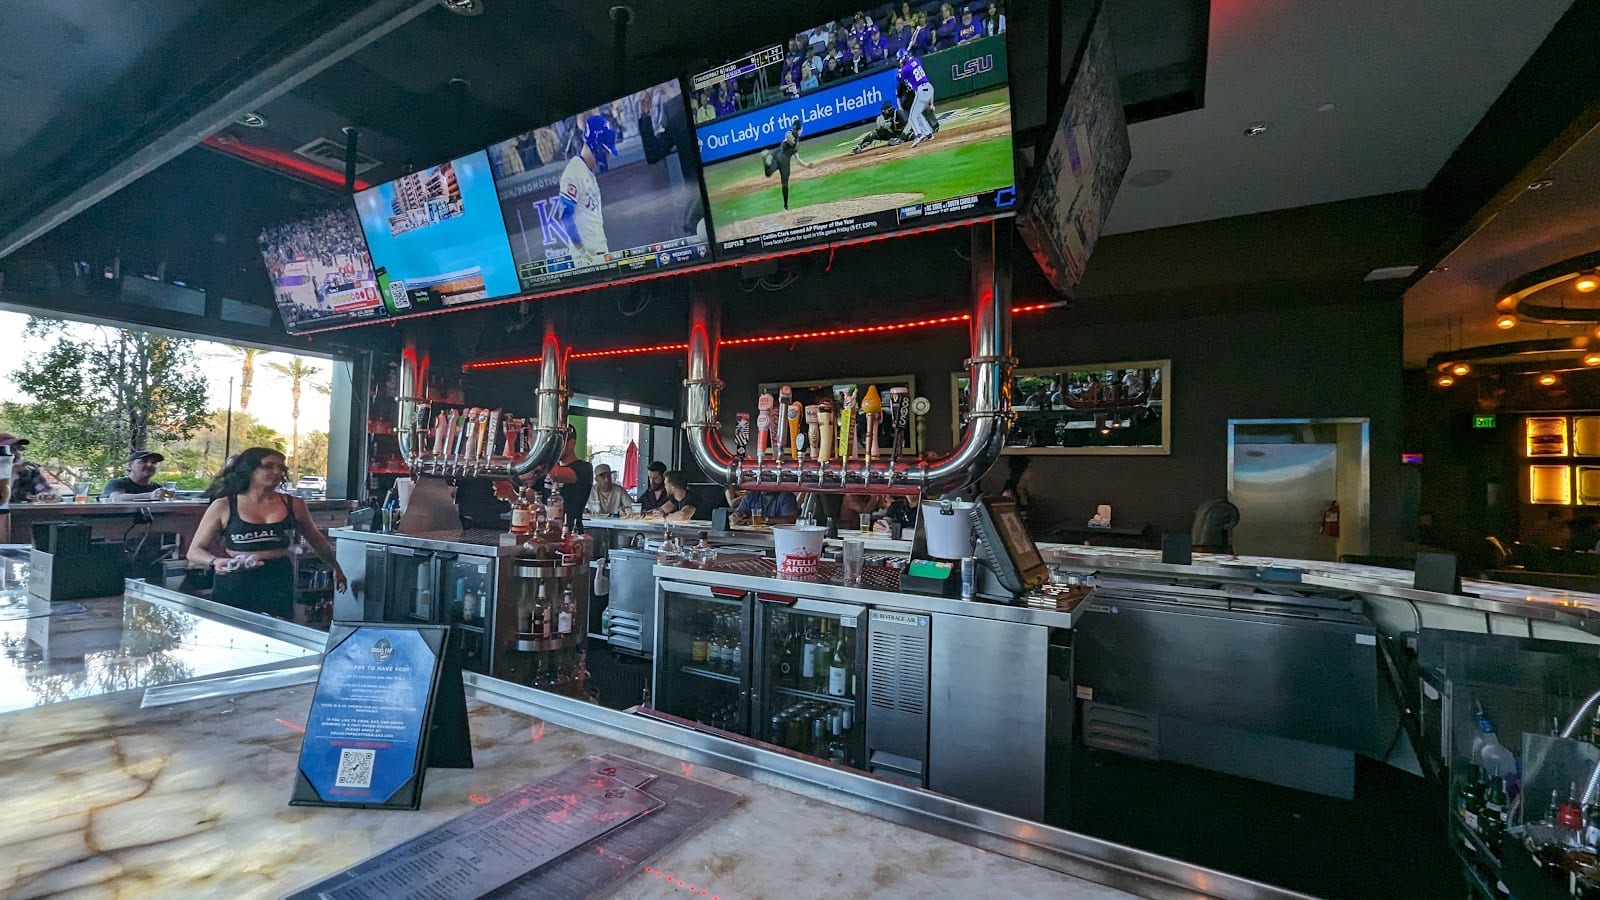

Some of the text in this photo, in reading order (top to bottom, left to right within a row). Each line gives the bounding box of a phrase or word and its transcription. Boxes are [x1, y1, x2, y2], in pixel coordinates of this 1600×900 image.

[952, 54, 993, 80] LSU
[707, 86, 882, 149] Our Lady of the Lake Health
[898, 397, 910, 426] 805
[1475, 417, 1493, 428] EXIT
